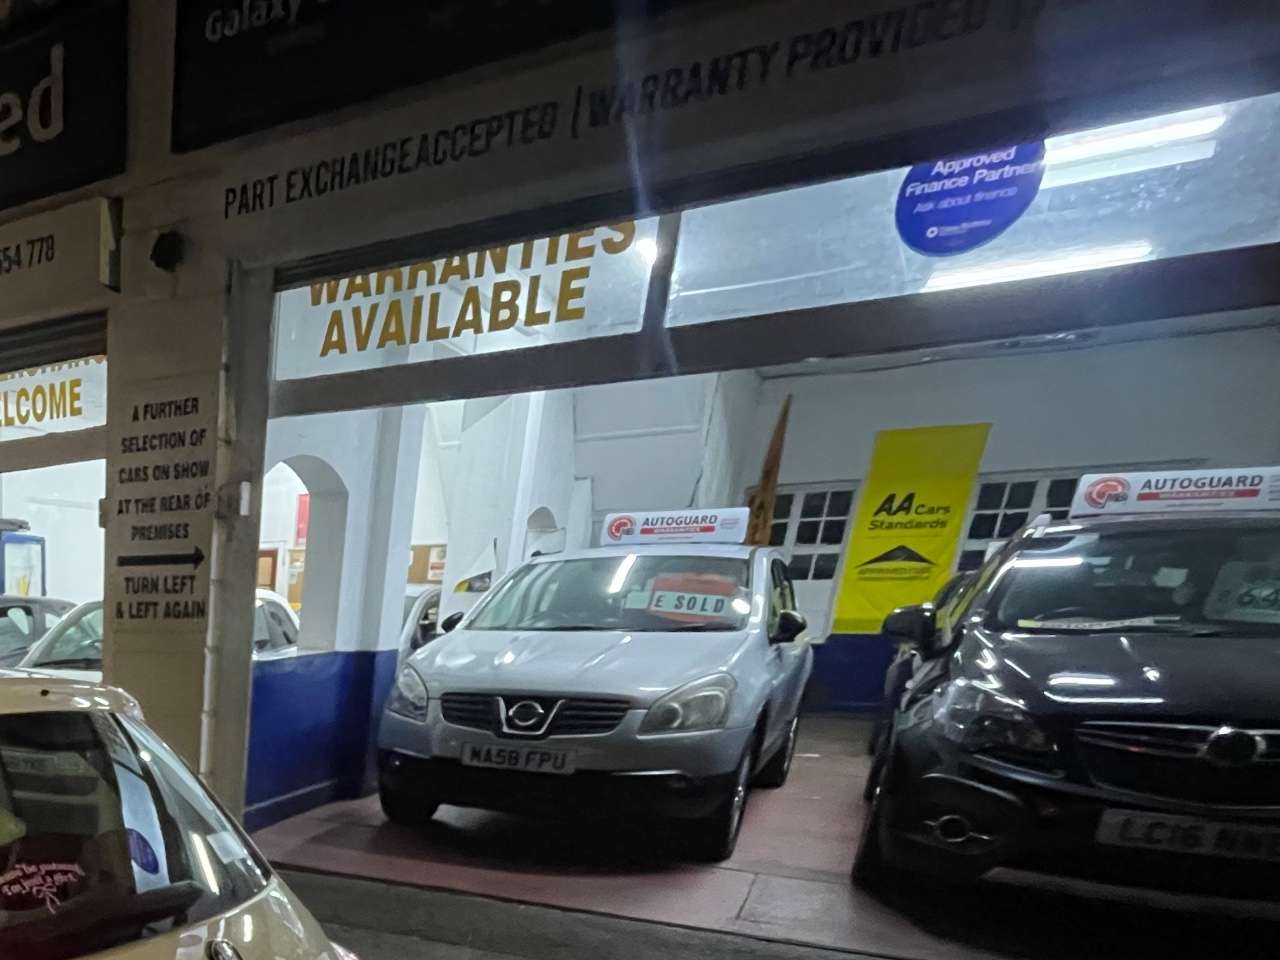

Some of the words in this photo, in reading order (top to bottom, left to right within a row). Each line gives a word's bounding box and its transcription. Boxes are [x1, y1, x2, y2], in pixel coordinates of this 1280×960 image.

[224, 175, 278, 219] PART
[588, 41, 780, 128] WARRANTY
[786, 0, 986, 78] PROVIDED
[931, 146, 1017, 176] Approved
[905, 176, 970, 197] Finance
[972, 162, 1042, 184] Partner
[26, 234, 56, 268] 778
[319, 266, 591, 358] AVAILABLE
[131, 405, 140, 422] A
[143, 397, 200, 422] FURTHER
[121, 431, 186, 454] SELECTION
[189, 429, 207, 447] OF
[119, 466, 149, 484] CARS
[152, 464, 170, 481] ON
[173, 461, 209, 480] SHOW
[1140, 475, 1264, 490] AUTOGUARD
[117, 499, 131, 516] AT
[134, 498, 156, 514] THE
[160, 495, 191, 512] REAR
[195, 493, 211, 510] OF
[872, 492, 916, 517] AA
[914, 504, 952, 515] Cars
[131, 523, 190, 541] PREMISES
[642, 514, 718, 527] AUTOGUARD
[867, 518, 948, 530] Standards
[124, 576, 161, 595] TURN
[163, 575, 196, 594] LEFT
[116, 603, 124, 619] &
[128, 602, 159, 619] LEFT
[163, 601, 207, 619] AGAIN
[673, 595, 725, 613] SOLD
[469, 747, 519, 766] MA58
[523, 752, 568, 770] FPU
